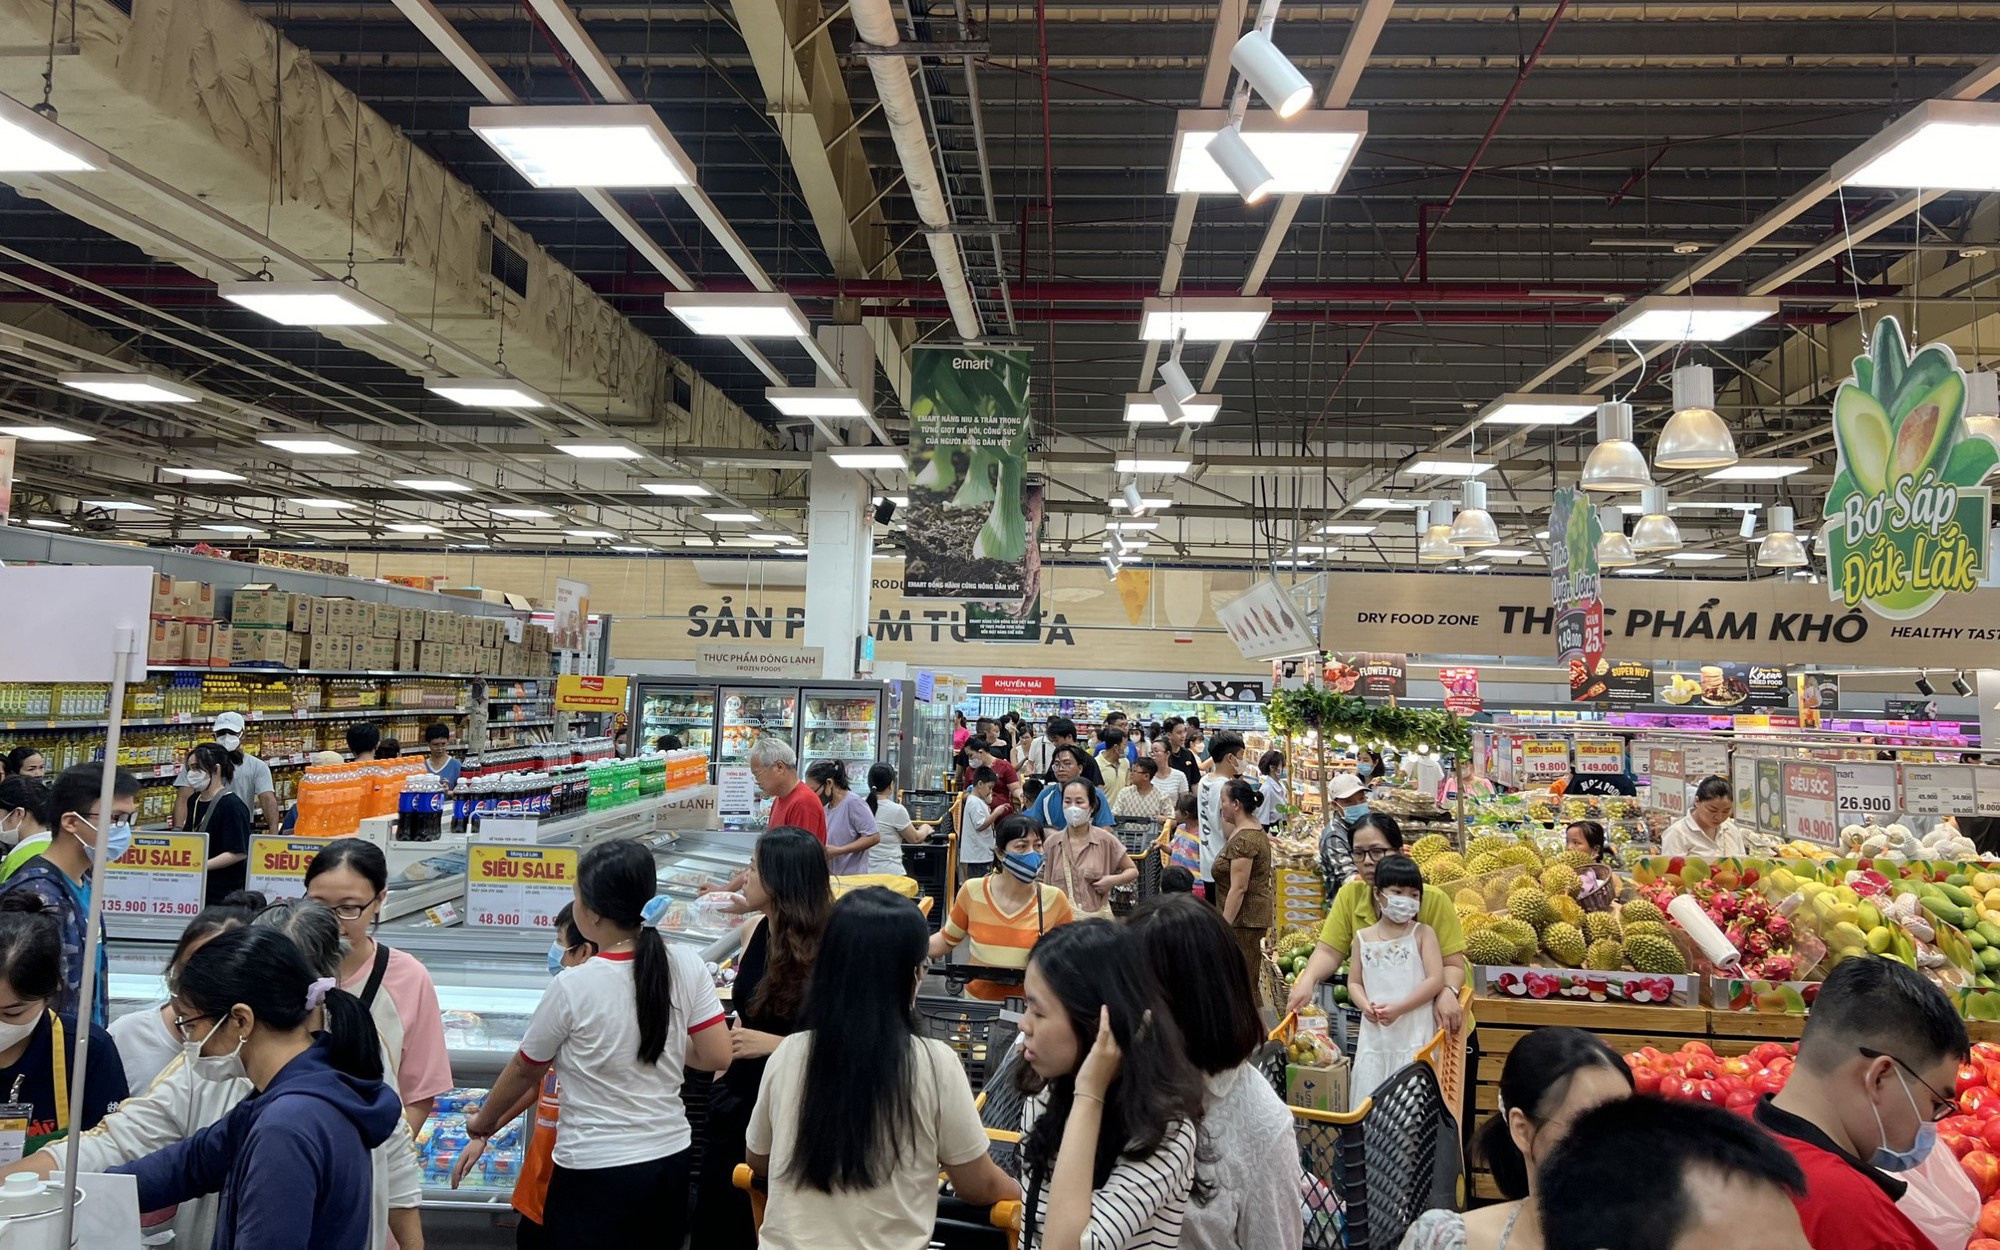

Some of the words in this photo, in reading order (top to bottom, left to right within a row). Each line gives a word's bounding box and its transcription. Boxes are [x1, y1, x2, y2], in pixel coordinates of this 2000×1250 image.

[953, 355, 989, 370] emart
[999, 417, 1021, 425] TRỌNG
[940, 426, 955, 435] GIỌT
[983, 427, 1001, 435] CÔNG
[1002, 427, 1017, 435] SỨC
[925, 436, 939, 445] CỦA
[962, 438, 981, 446] NÔNG
[997, 439, 1011, 447] VIỆT
[1844, 491, 1887, 545] Bơ
[1890, 471, 1957, 537] Sáp
[1912, 526, 1977, 592] Lắk
[978, 581, 993, 590] NÔNG
[1007, 583, 1020, 592] VIỆT
[687, 596, 772, 638] SẢN
[1357, 611, 1387, 625] DRY
[1390, 612, 1436, 626] FOOD
[1438, 613, 1479, 627] ZONE
[1627, 597, 1758, 641] PHẨM
[1768, 606, 1869, 644] KHÔ
[1890, 626, 1964, 639] HEALTHY
[703, 653, 729, 663] THỰC
[730, 651, 758, 663] PHẨM
[760, 654, 788, 664] ĐÔNG
[790, 655, 816, 666] LẠNH
[1359, 666, 1388, 677] FLOWER
[1388, 667, 1402, 678] TEA
[1611, 666, 1634, 677] SUPER
[1634, 667, 1651, 678] NUT
[1749, 666, 1783, 680] Korean
[994, 678, 1026, 688] KHUYẾN
[1027, 680, 1042, 689] MÃI
[1528, 745, 1544, 754] SIÊU
[1545, 746, 1562, 754] SALE
[1582, 746, 1598, 754] SIÊU
[1599, 746, 1616, 754] SALE
[1534, 762, 1567, 771] 19.800
[1582, 763, 1619, 772] 149.000
[1835, 770, 1854, 779] mart
[1908, 772, 1932, 781] emart
[679, 799, 714, 812] LẠNH
[1840, 796, 1891, 811] 26.900
[1798, 817, 1834, 842] 49.900
[150, 849, 191, 867] SALE
[264, 850, 300, 871] SIÊU
[481, 857, 519, 878] SIÊU
[522, 861, 565, 879] SALE
[101, 900, 147, 912] 135.900
[152, 902, 198, 915] 125.900
[478, 913, 520, 925] 48.900
[533, 915, 558, 927] 48.9
